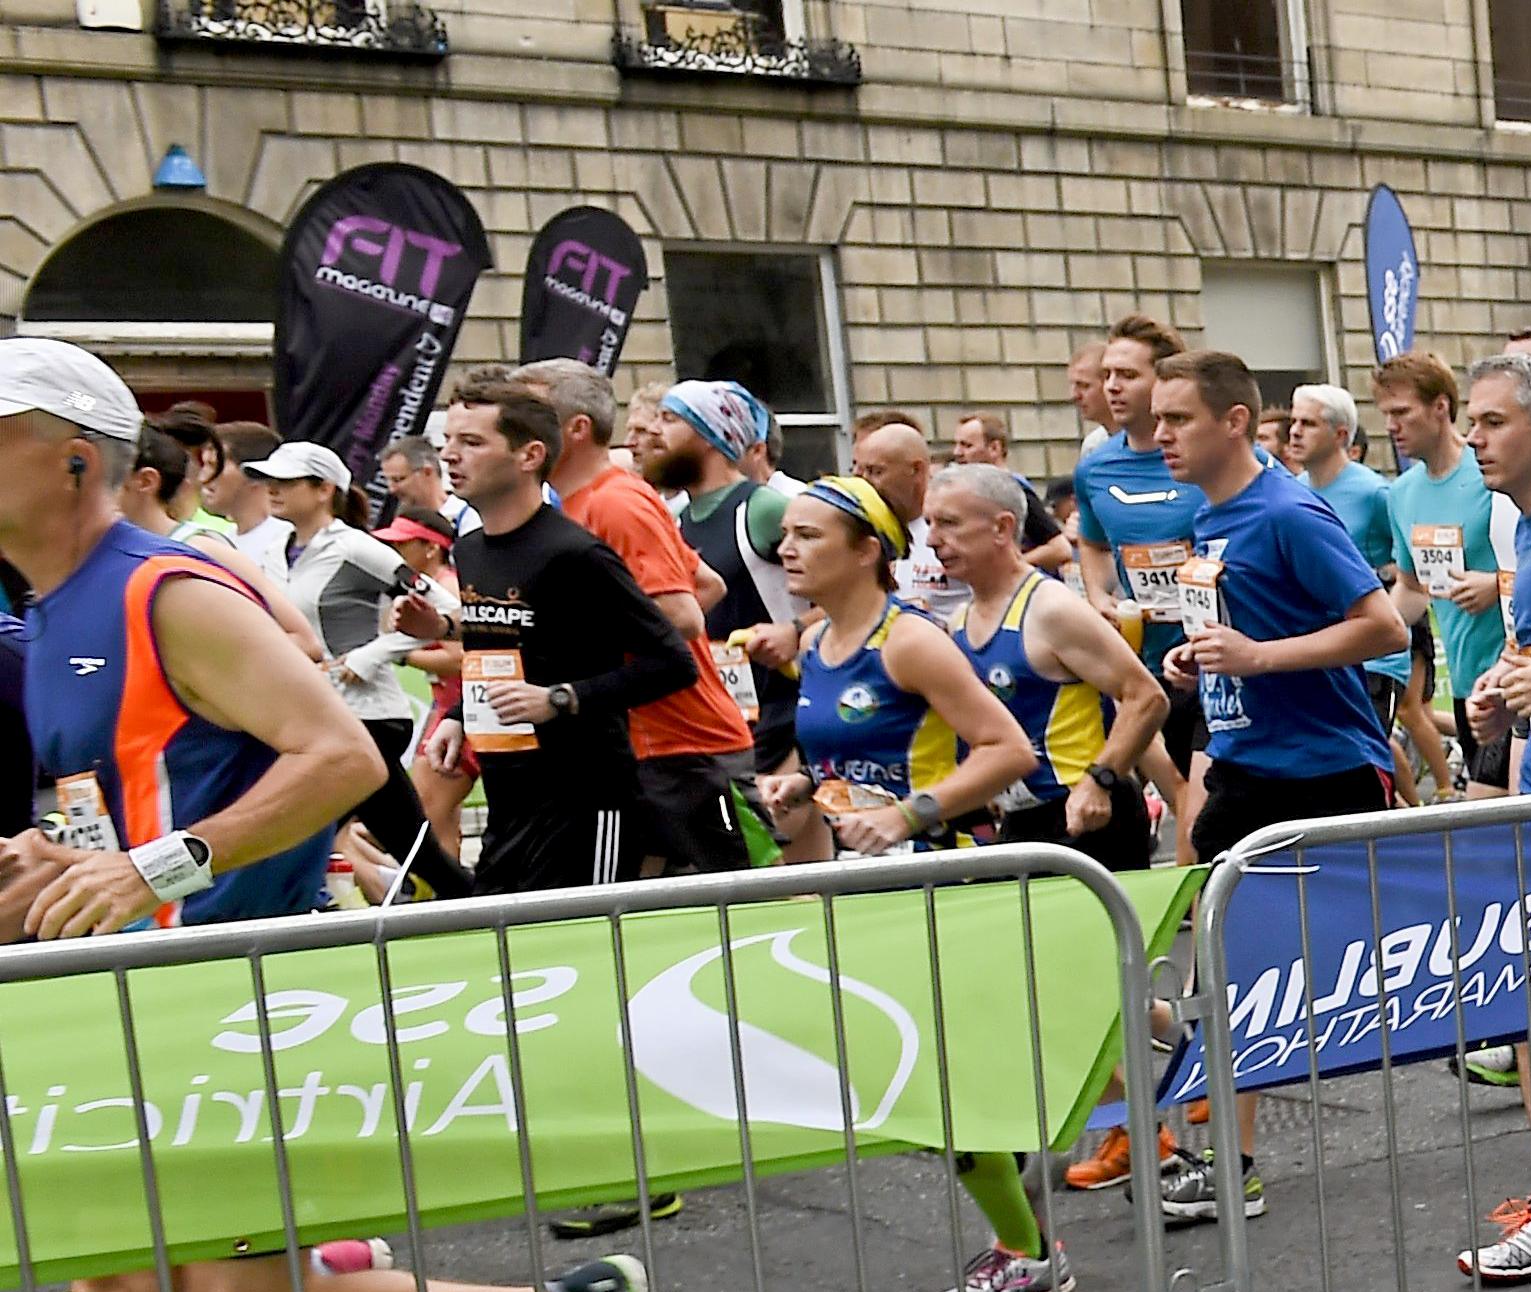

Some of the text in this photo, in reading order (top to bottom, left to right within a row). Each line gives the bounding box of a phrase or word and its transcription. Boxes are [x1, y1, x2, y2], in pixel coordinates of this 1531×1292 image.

[320, 214, 463, 299] FIT
[547, 239, 634, 307] FIT
[1422, 549, 1453, 564] 3504
